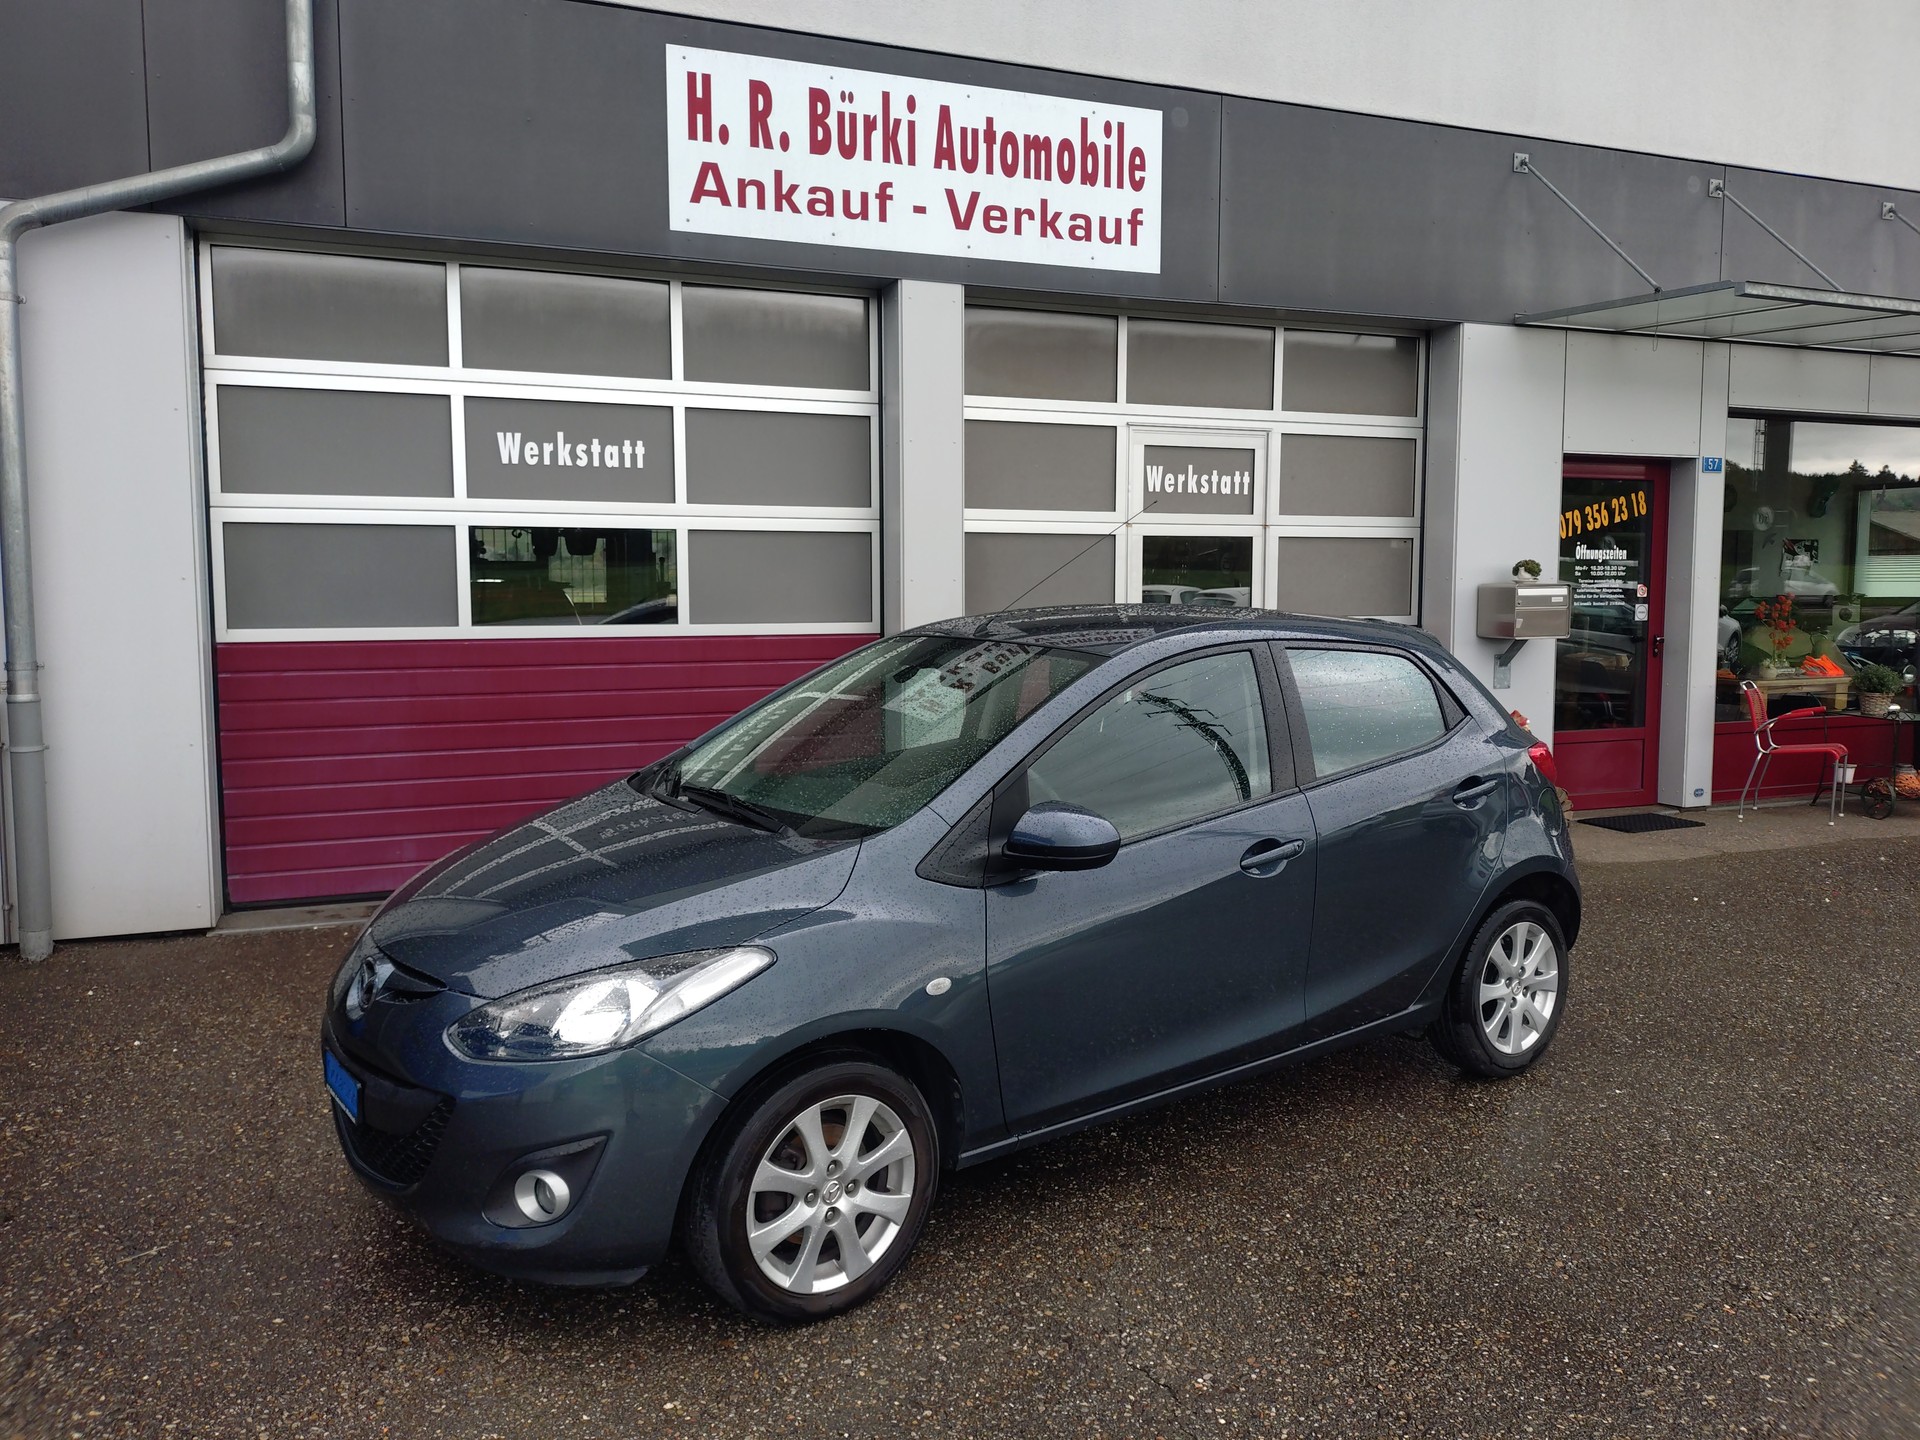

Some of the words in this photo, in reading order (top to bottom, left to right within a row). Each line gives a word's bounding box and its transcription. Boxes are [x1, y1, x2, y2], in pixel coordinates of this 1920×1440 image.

[686, 71, 730, 146] H.
[749, 79, 790, 153] R.
[809, 87, 917, 167] Bürki
[933, 104, 1147, 193] Automobile
[689, 161, 894, 223] Ankauf
[944, 188, 1144, 246] Verkauf
[496, 431, 646, 469] Werkstatt
[1708, 458, 1719, 470] 57
[1146, 464, 1250, 495] Werkstatt
[1560, 509, 1582, 539] 079
[1585, 501, 1609, 531] 356
[1611, 496, 1628, 524] 23
[1631, 490, 1647, 517] 18
[1575, 541, 1627, 563] Öffnungszeiten
